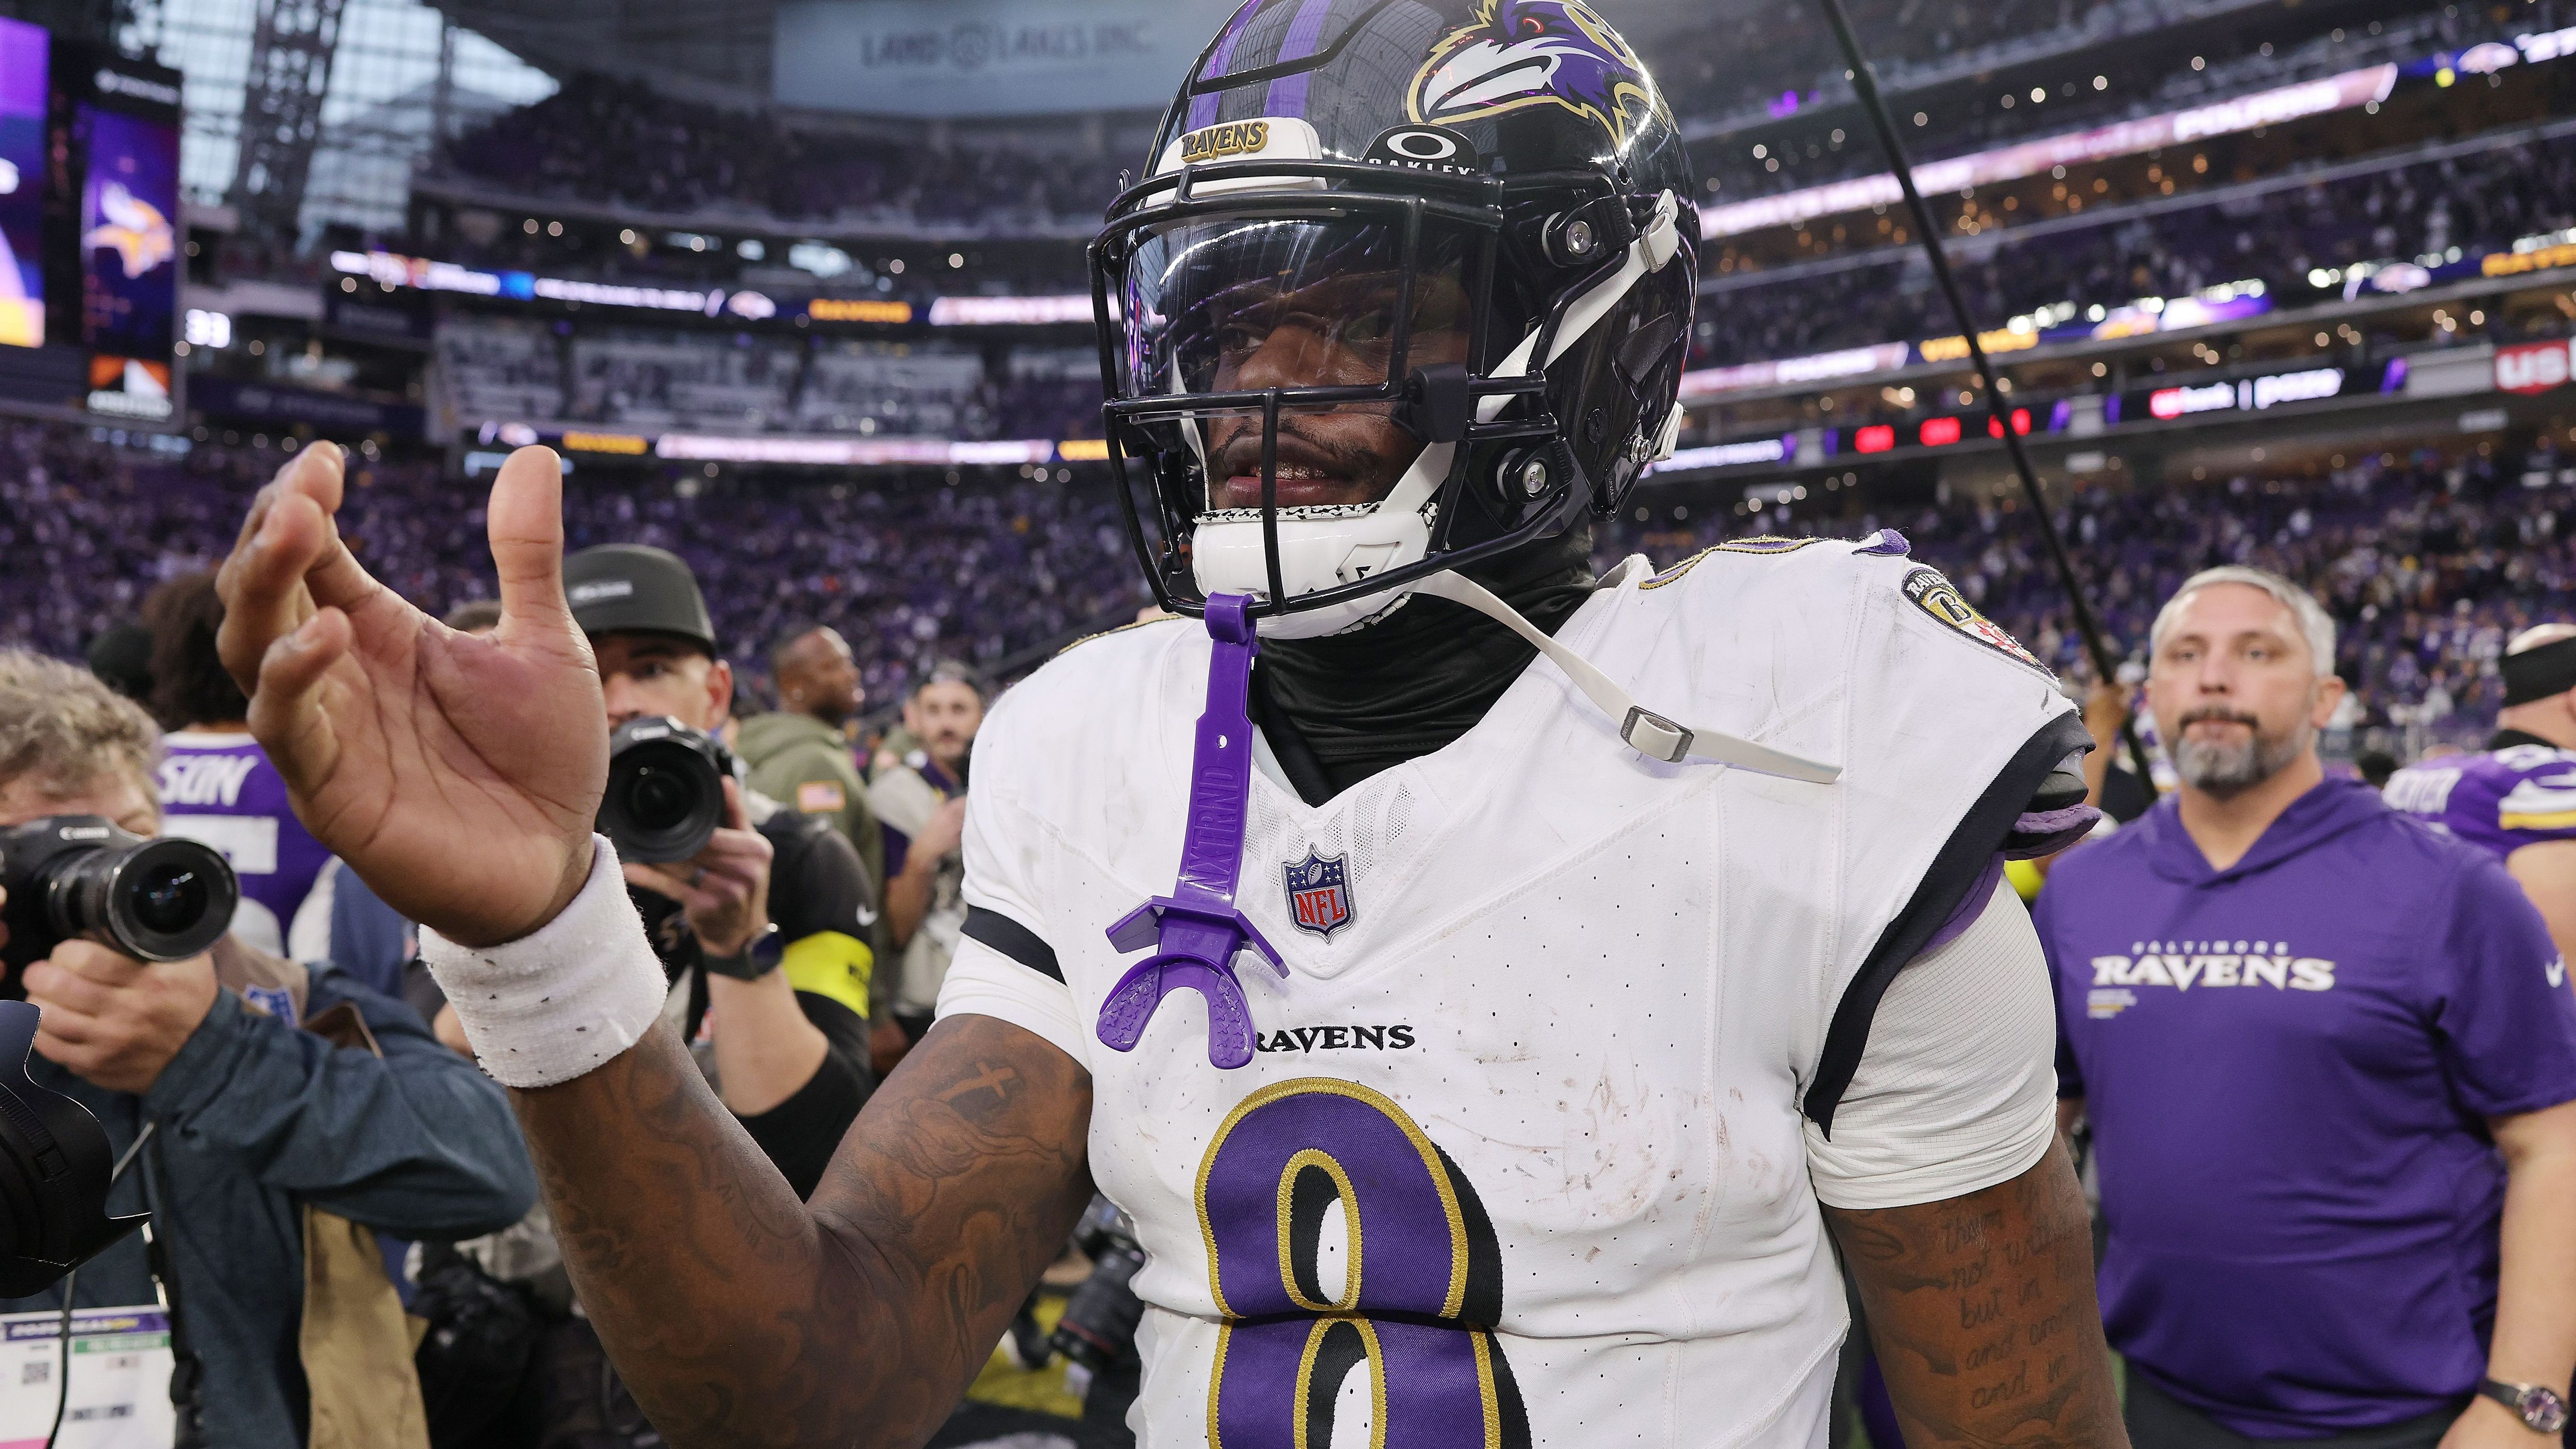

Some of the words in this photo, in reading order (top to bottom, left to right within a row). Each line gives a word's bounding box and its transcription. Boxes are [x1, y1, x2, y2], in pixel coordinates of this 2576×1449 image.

[1181, 122, 1269, 163] RAVENS
[1906, 573, 1950, 598] RAVE
[1184, 766, 1240, 894] NXTRND
[1295, 889, 1345, 926] NFL
[2132, 940, 2289, 956] BALTIMORE
[2091, 954, 2336, 992] RAVENS
[1194, 1077, 1532, 1449] 8
